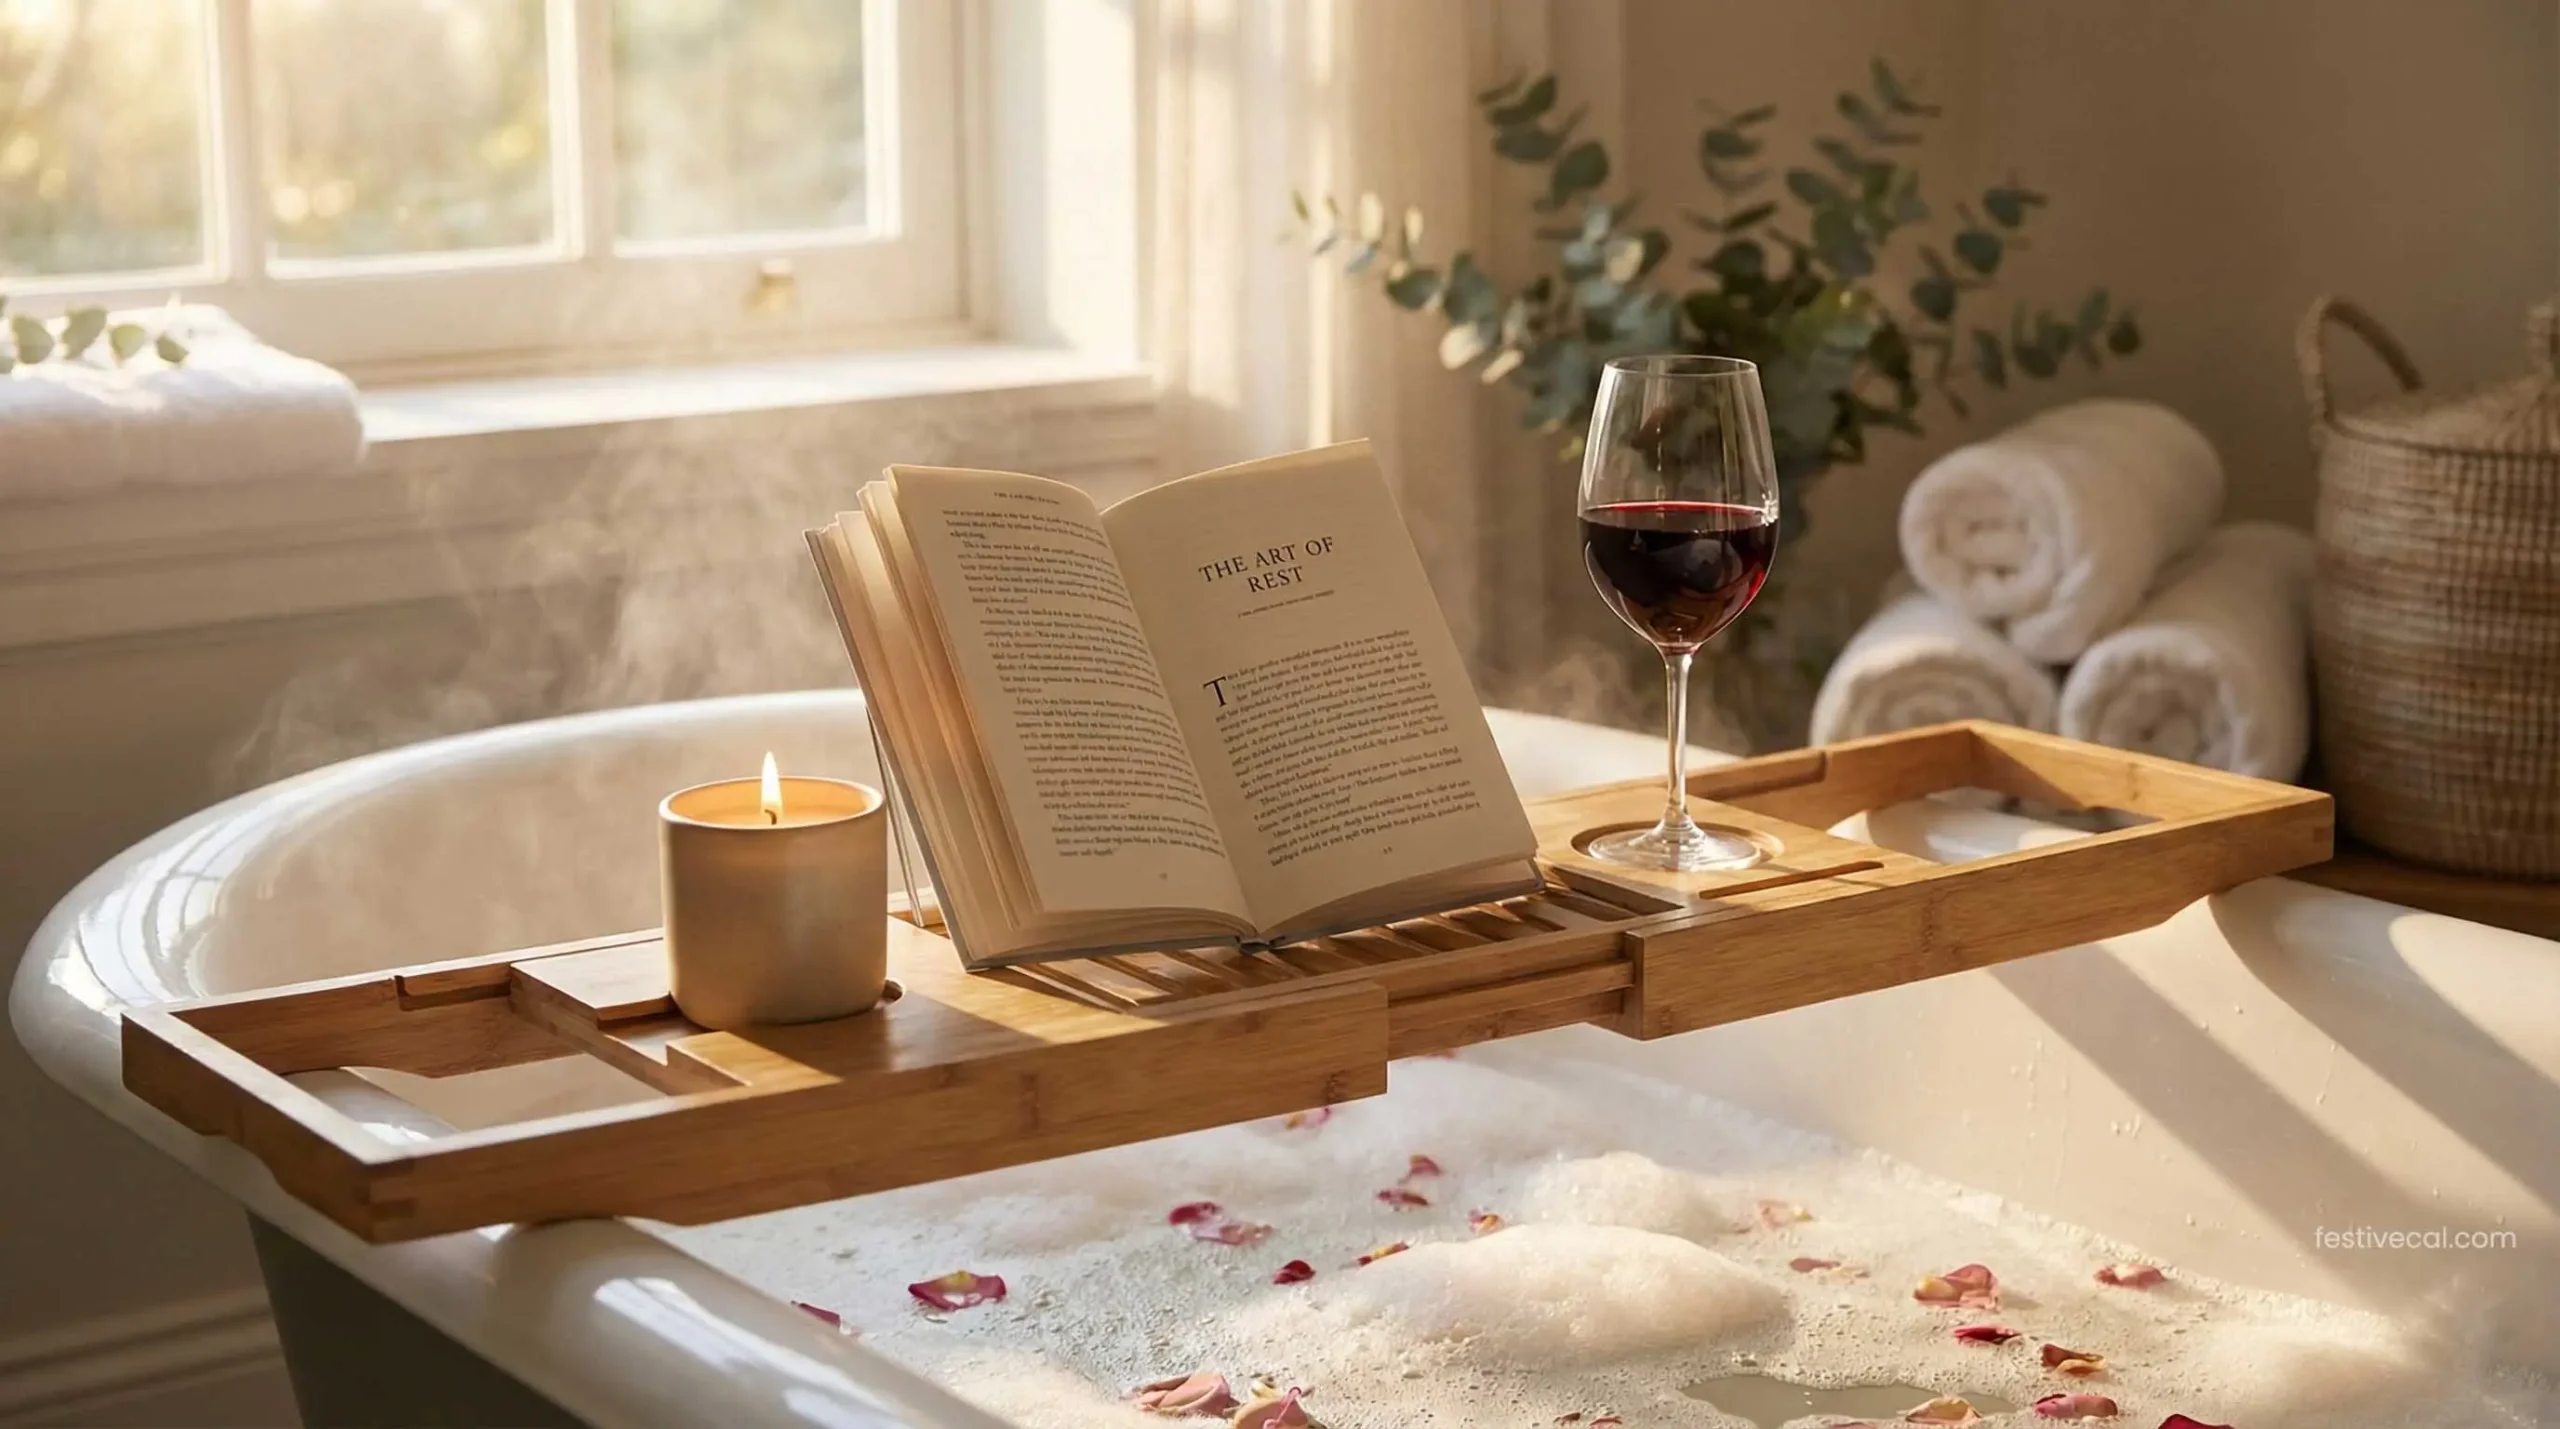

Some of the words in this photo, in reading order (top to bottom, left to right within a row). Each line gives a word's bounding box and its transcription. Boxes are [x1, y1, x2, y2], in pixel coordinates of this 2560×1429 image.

[1198, 556, 1248, 583] THE
[1255, 544, 1295, 568] ART
[1305, 536, 1333, 556] OF
[1247, 565, 1302, 593] REST
